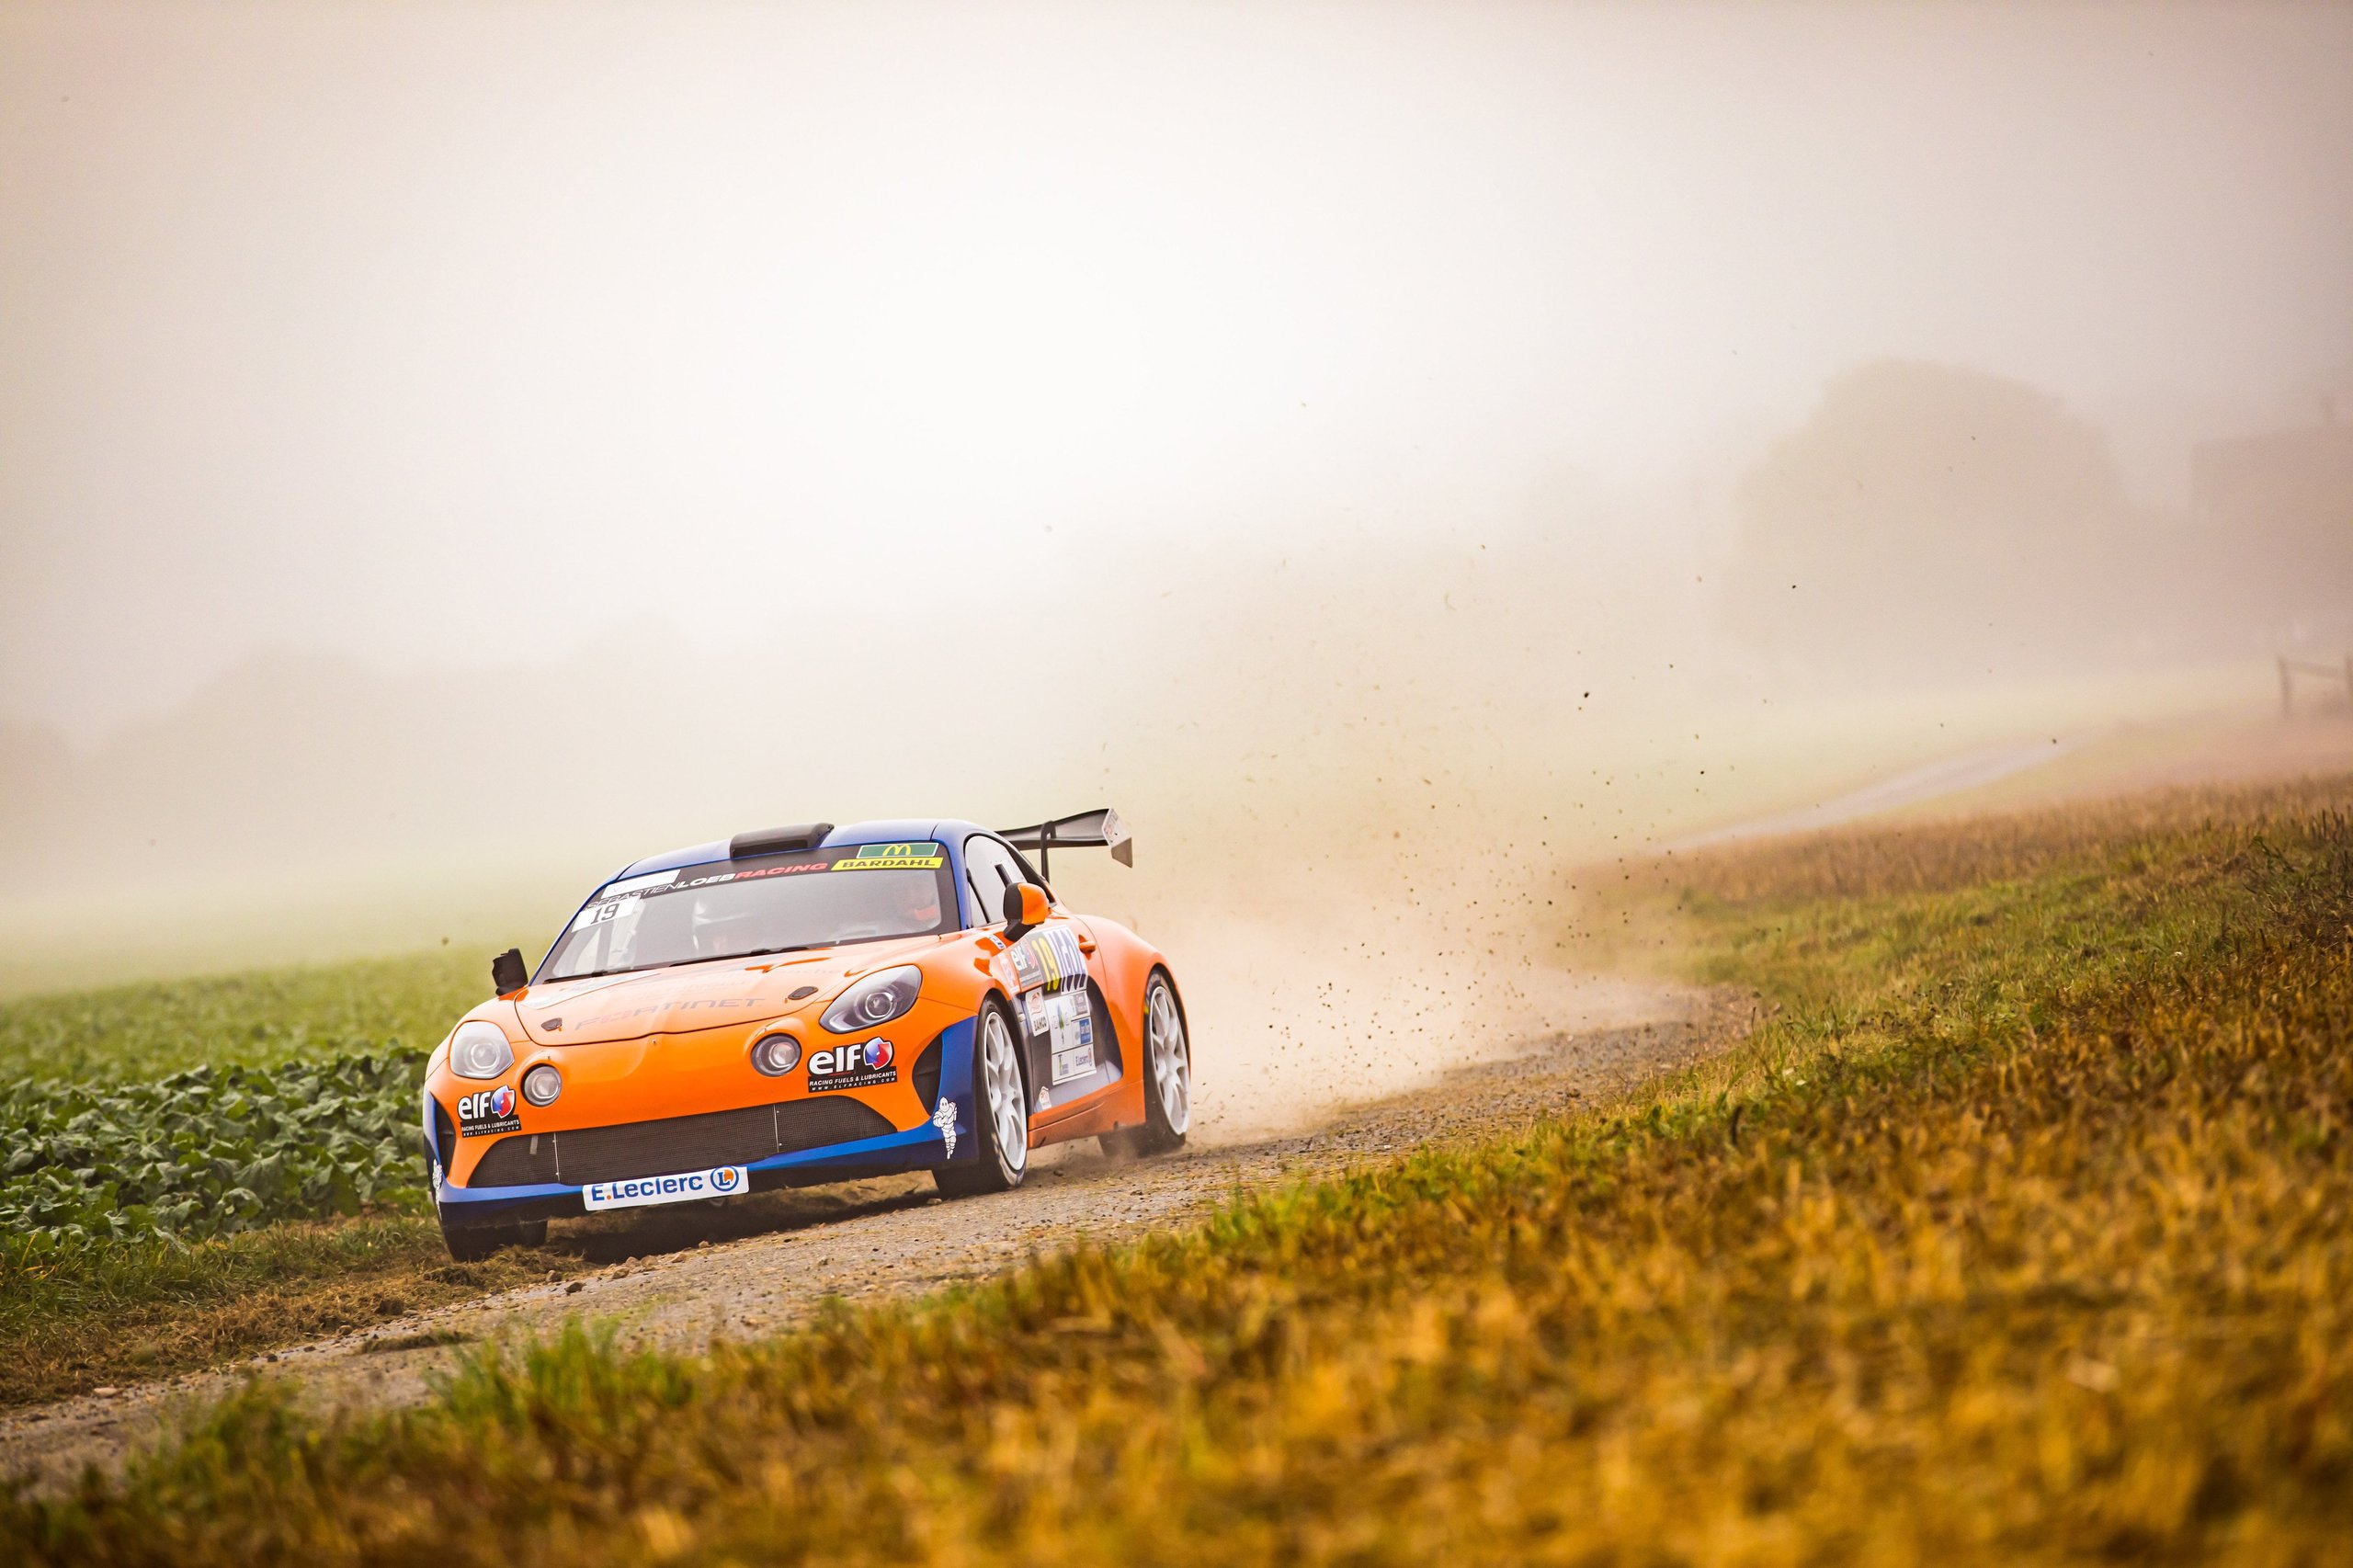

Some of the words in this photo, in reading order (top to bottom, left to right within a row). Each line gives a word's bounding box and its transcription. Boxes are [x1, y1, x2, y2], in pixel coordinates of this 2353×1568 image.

[842, 858, 937, 869] BARDAHL
[591, 903, 619, 925] 19
[1011, 944, 1028, 971] elf
[1030, 937, 1060, 991] 19
[574, 997, 767, 1030] FORTINET
[809, 1044, 861, 1074] elf
[809, 1077, 833, 1086] RACING
[835, 1075, 853, 1085] FUELS
[860, 1071, 897, 1081] LUBRICANTS
[458, 1092, 491, 1119] elf
[491, 1119, 520, 1129] LUBRICANTS
[591, 1176, 703, 1201] E.Leclerc
